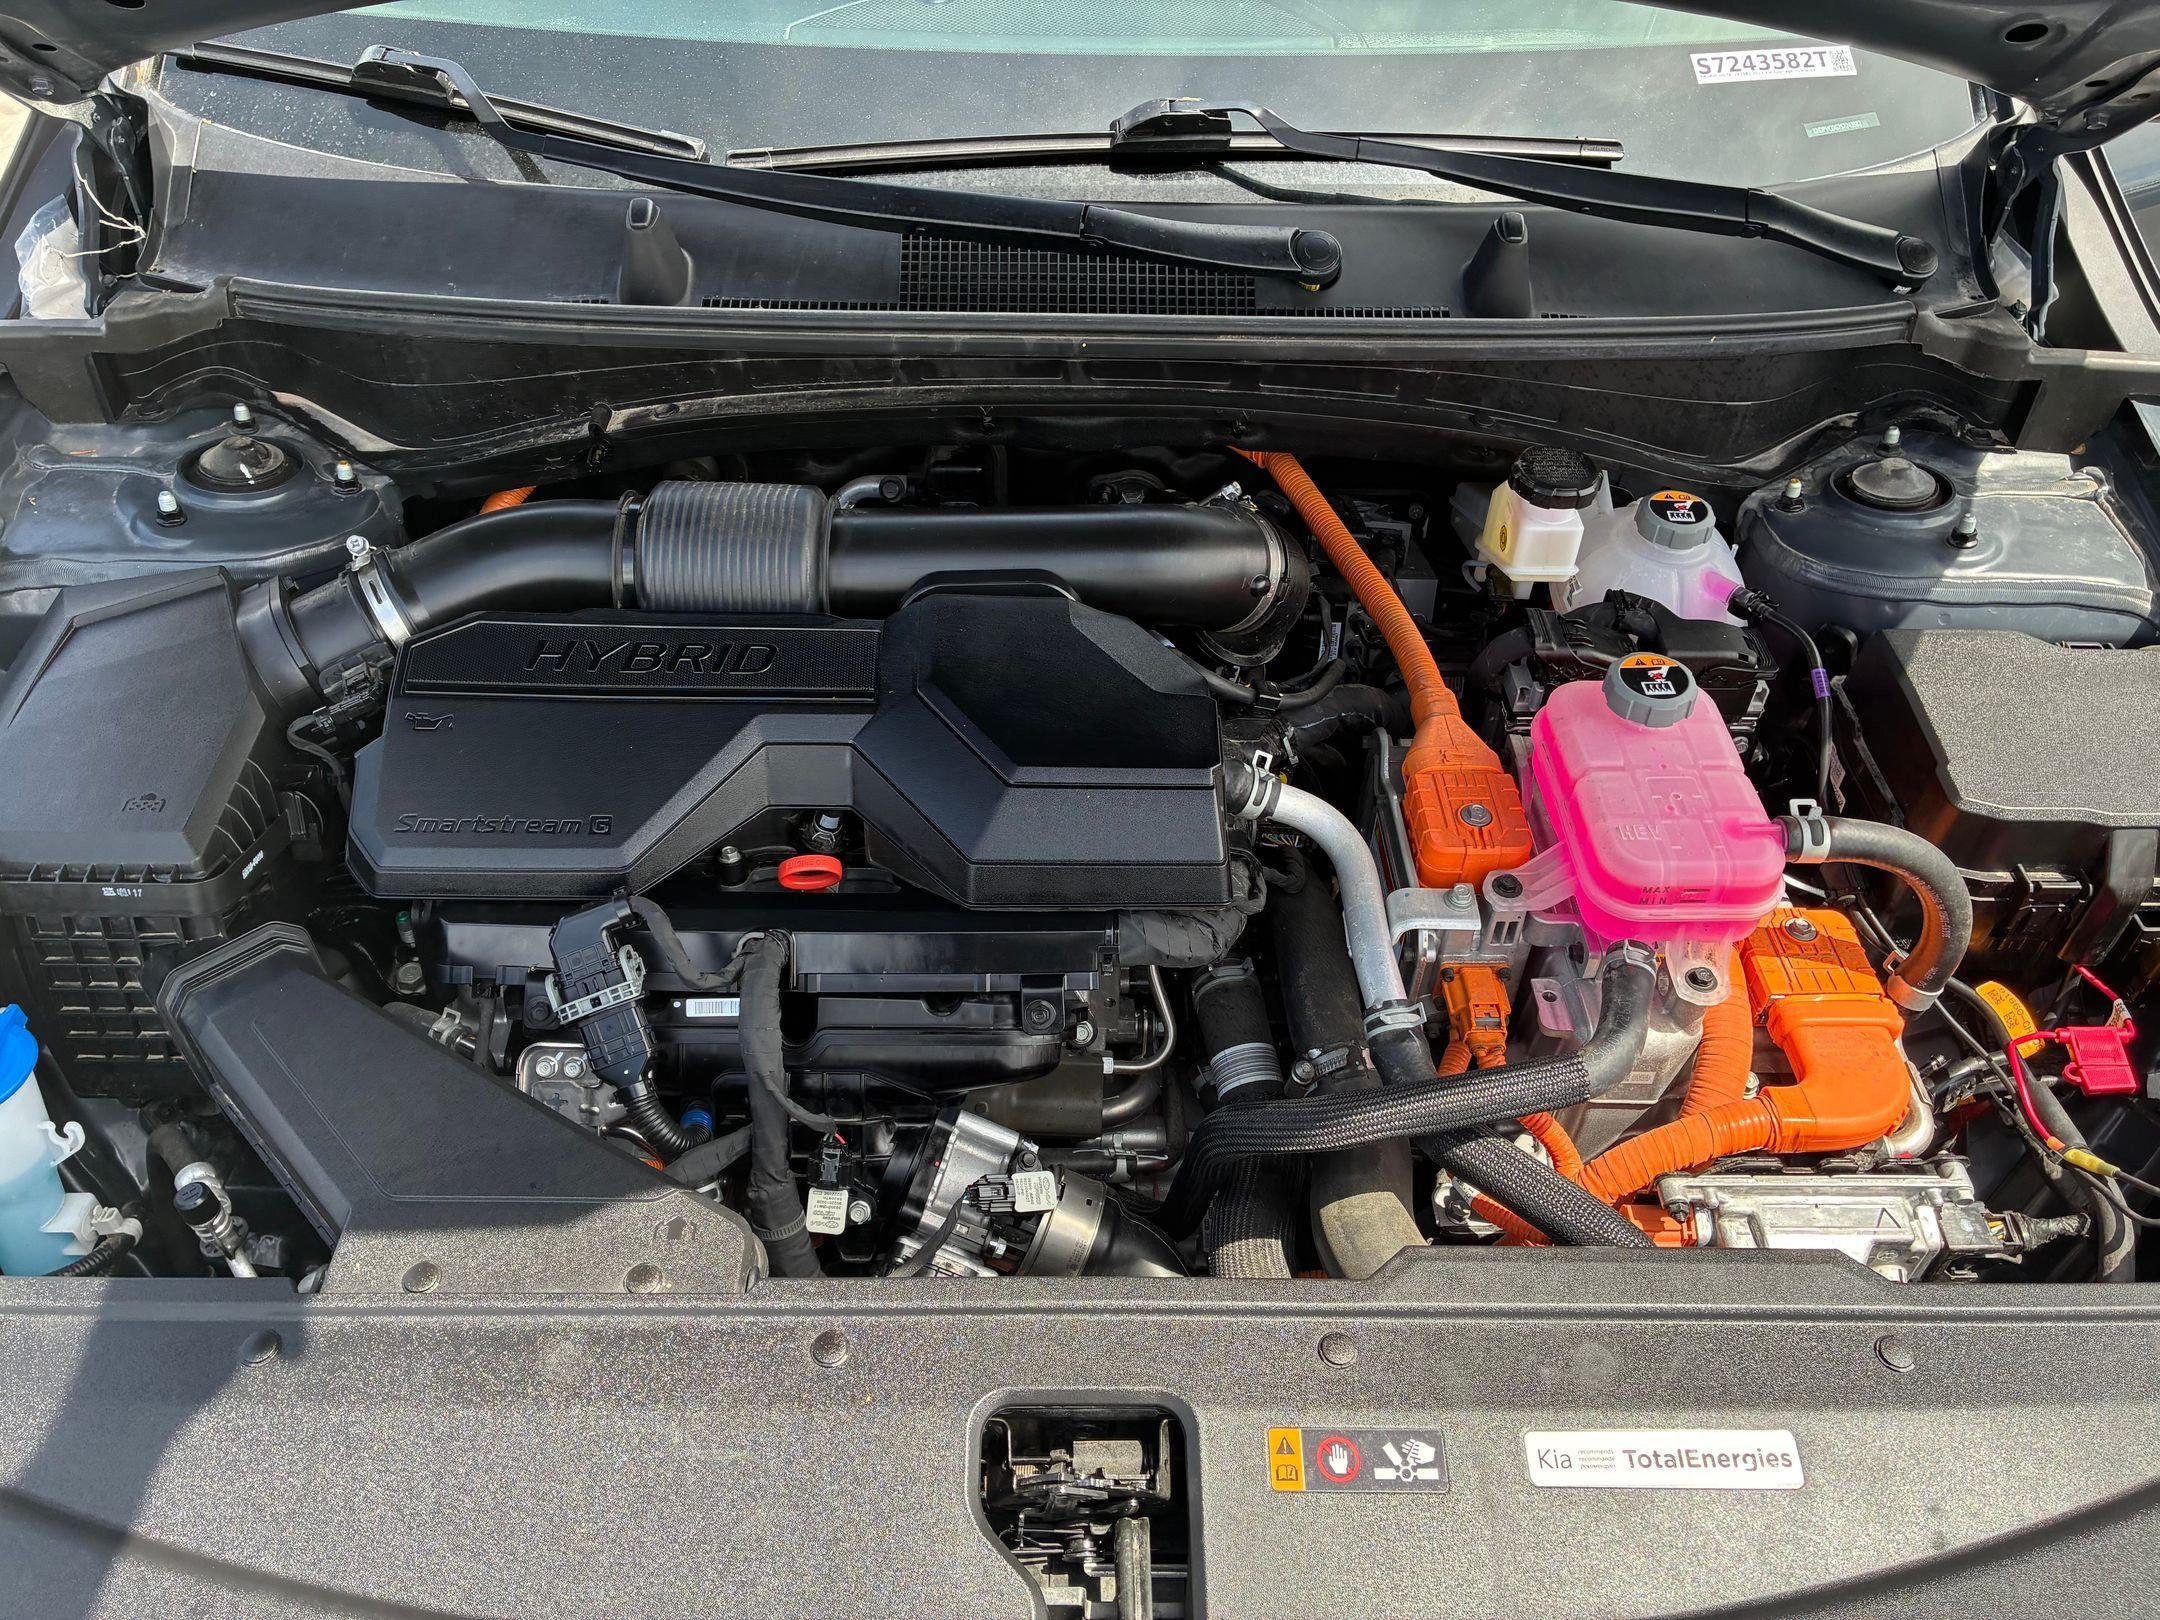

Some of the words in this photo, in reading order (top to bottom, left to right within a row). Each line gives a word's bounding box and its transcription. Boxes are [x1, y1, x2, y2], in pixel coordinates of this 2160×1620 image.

[1697, 51, 1827, 75] S7243582T
[523, 639, 779, 675] HYBRID
[394, 813, 583, 834] Smartstream
[1639, 897, 1667, 905] MIN
[1642, 886, 1670, 894] MAX
[1537, 1448, 1572, 1469] Kia
[1622, 1448, 1793, 1472] TotalEnergies
